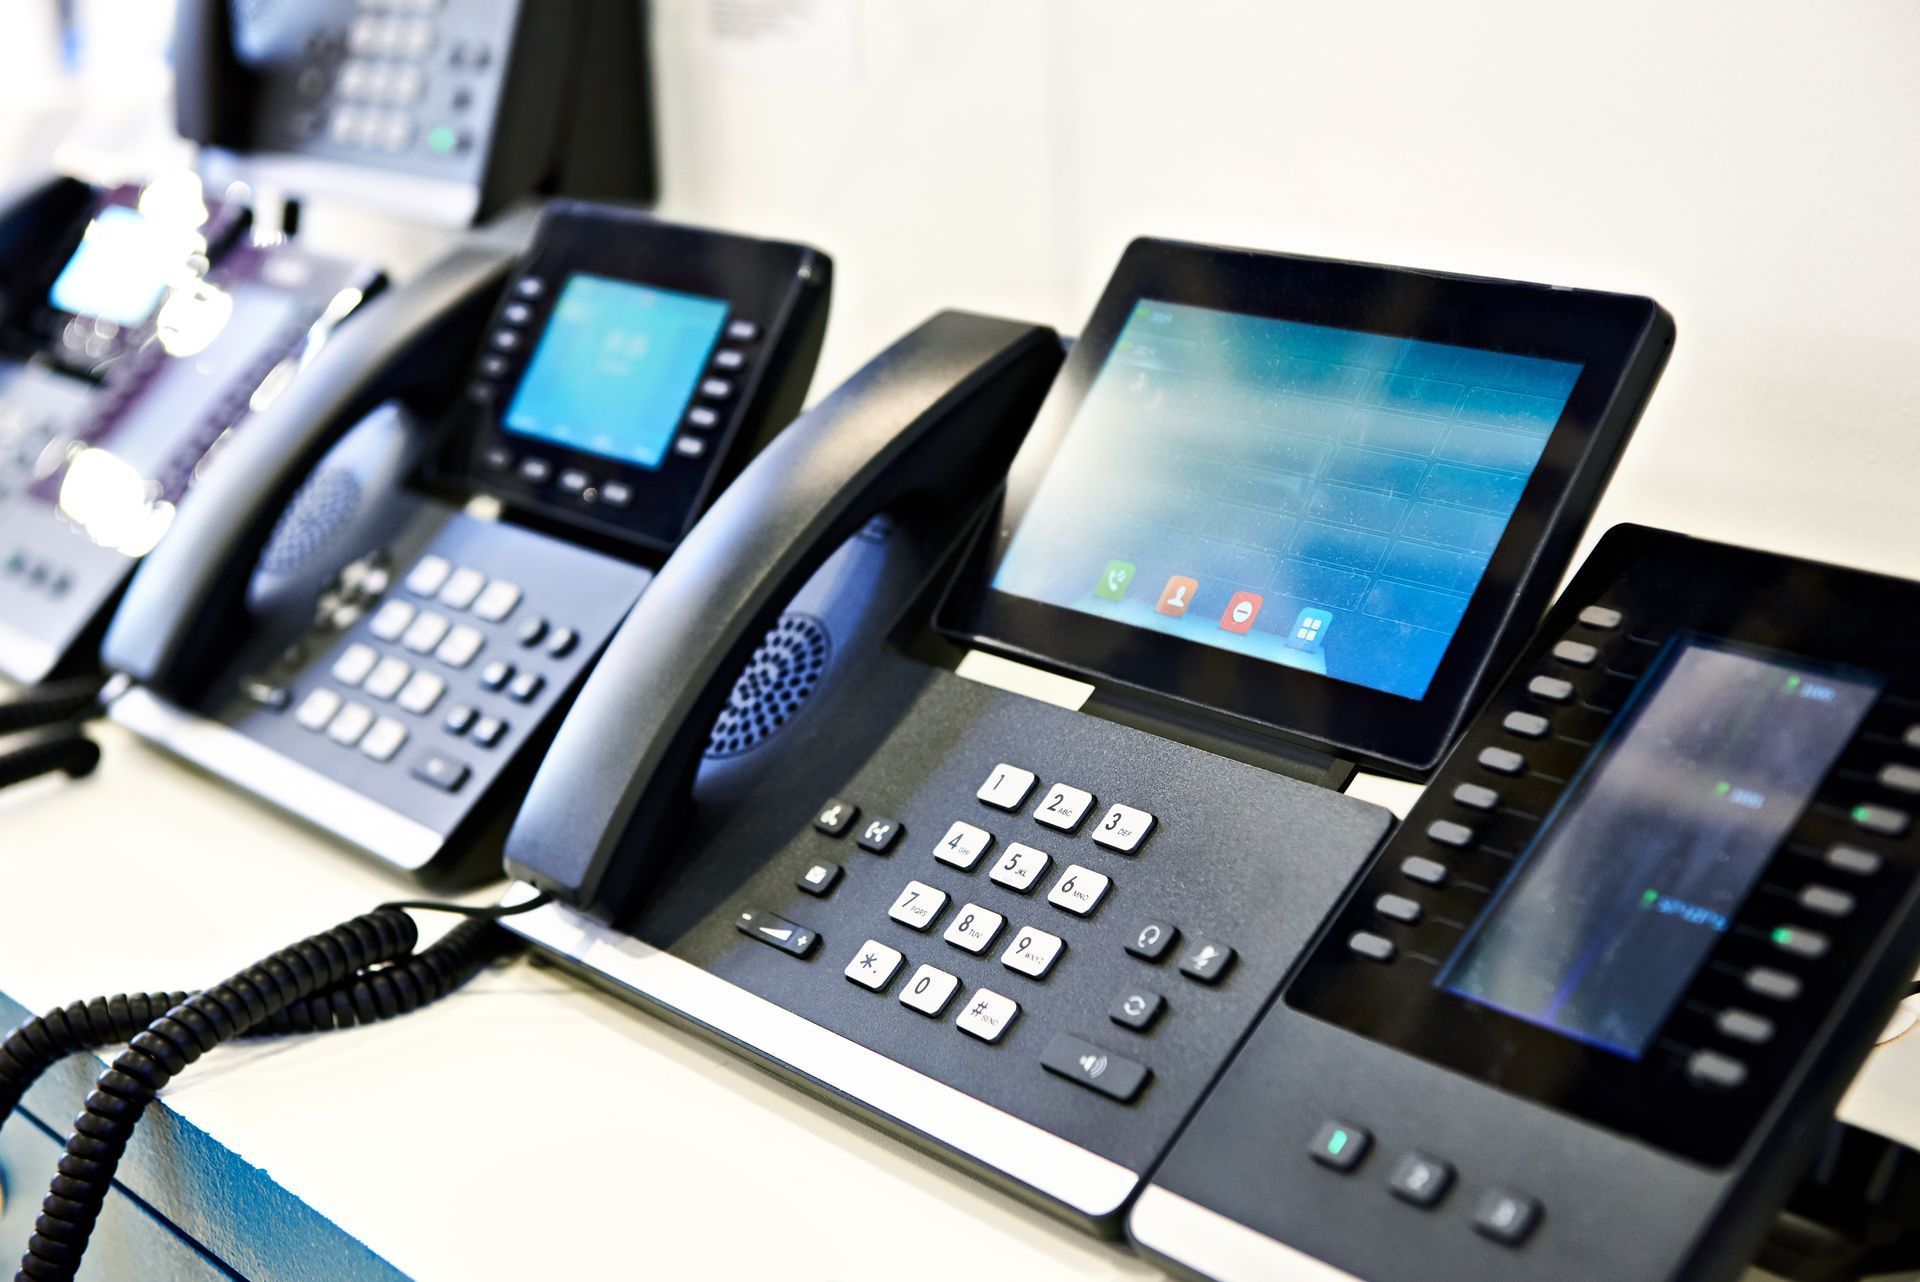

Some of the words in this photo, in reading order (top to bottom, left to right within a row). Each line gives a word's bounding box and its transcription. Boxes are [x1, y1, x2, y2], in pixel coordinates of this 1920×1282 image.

[993, 774, 1006, 790] 1
[1046, 793, 1064, 812] 2
[1058, 807, 1073, 817] ABC
[1105, 812, 1122, 831] 3
[1117, 827, 1133, 837] DEF
[947, 833, 964, 849] 4
[1004, 853, 1022, 871] 5
[1014, 867, 1027, 878] JKL
[1061, 875, 1078, 893] 6
[1073, 889, 1089, 901] MNO
[901, 891, 921, 908] 7
[910, 904, 928, 918] PQRS
[958, 914, 975, 932] 8
[968, 928, 983, 939] TUV
[1015, 936, 1032, 954] 9
[914, 976, 931, 995] 0
[970, 1001, 989, 1017] #
